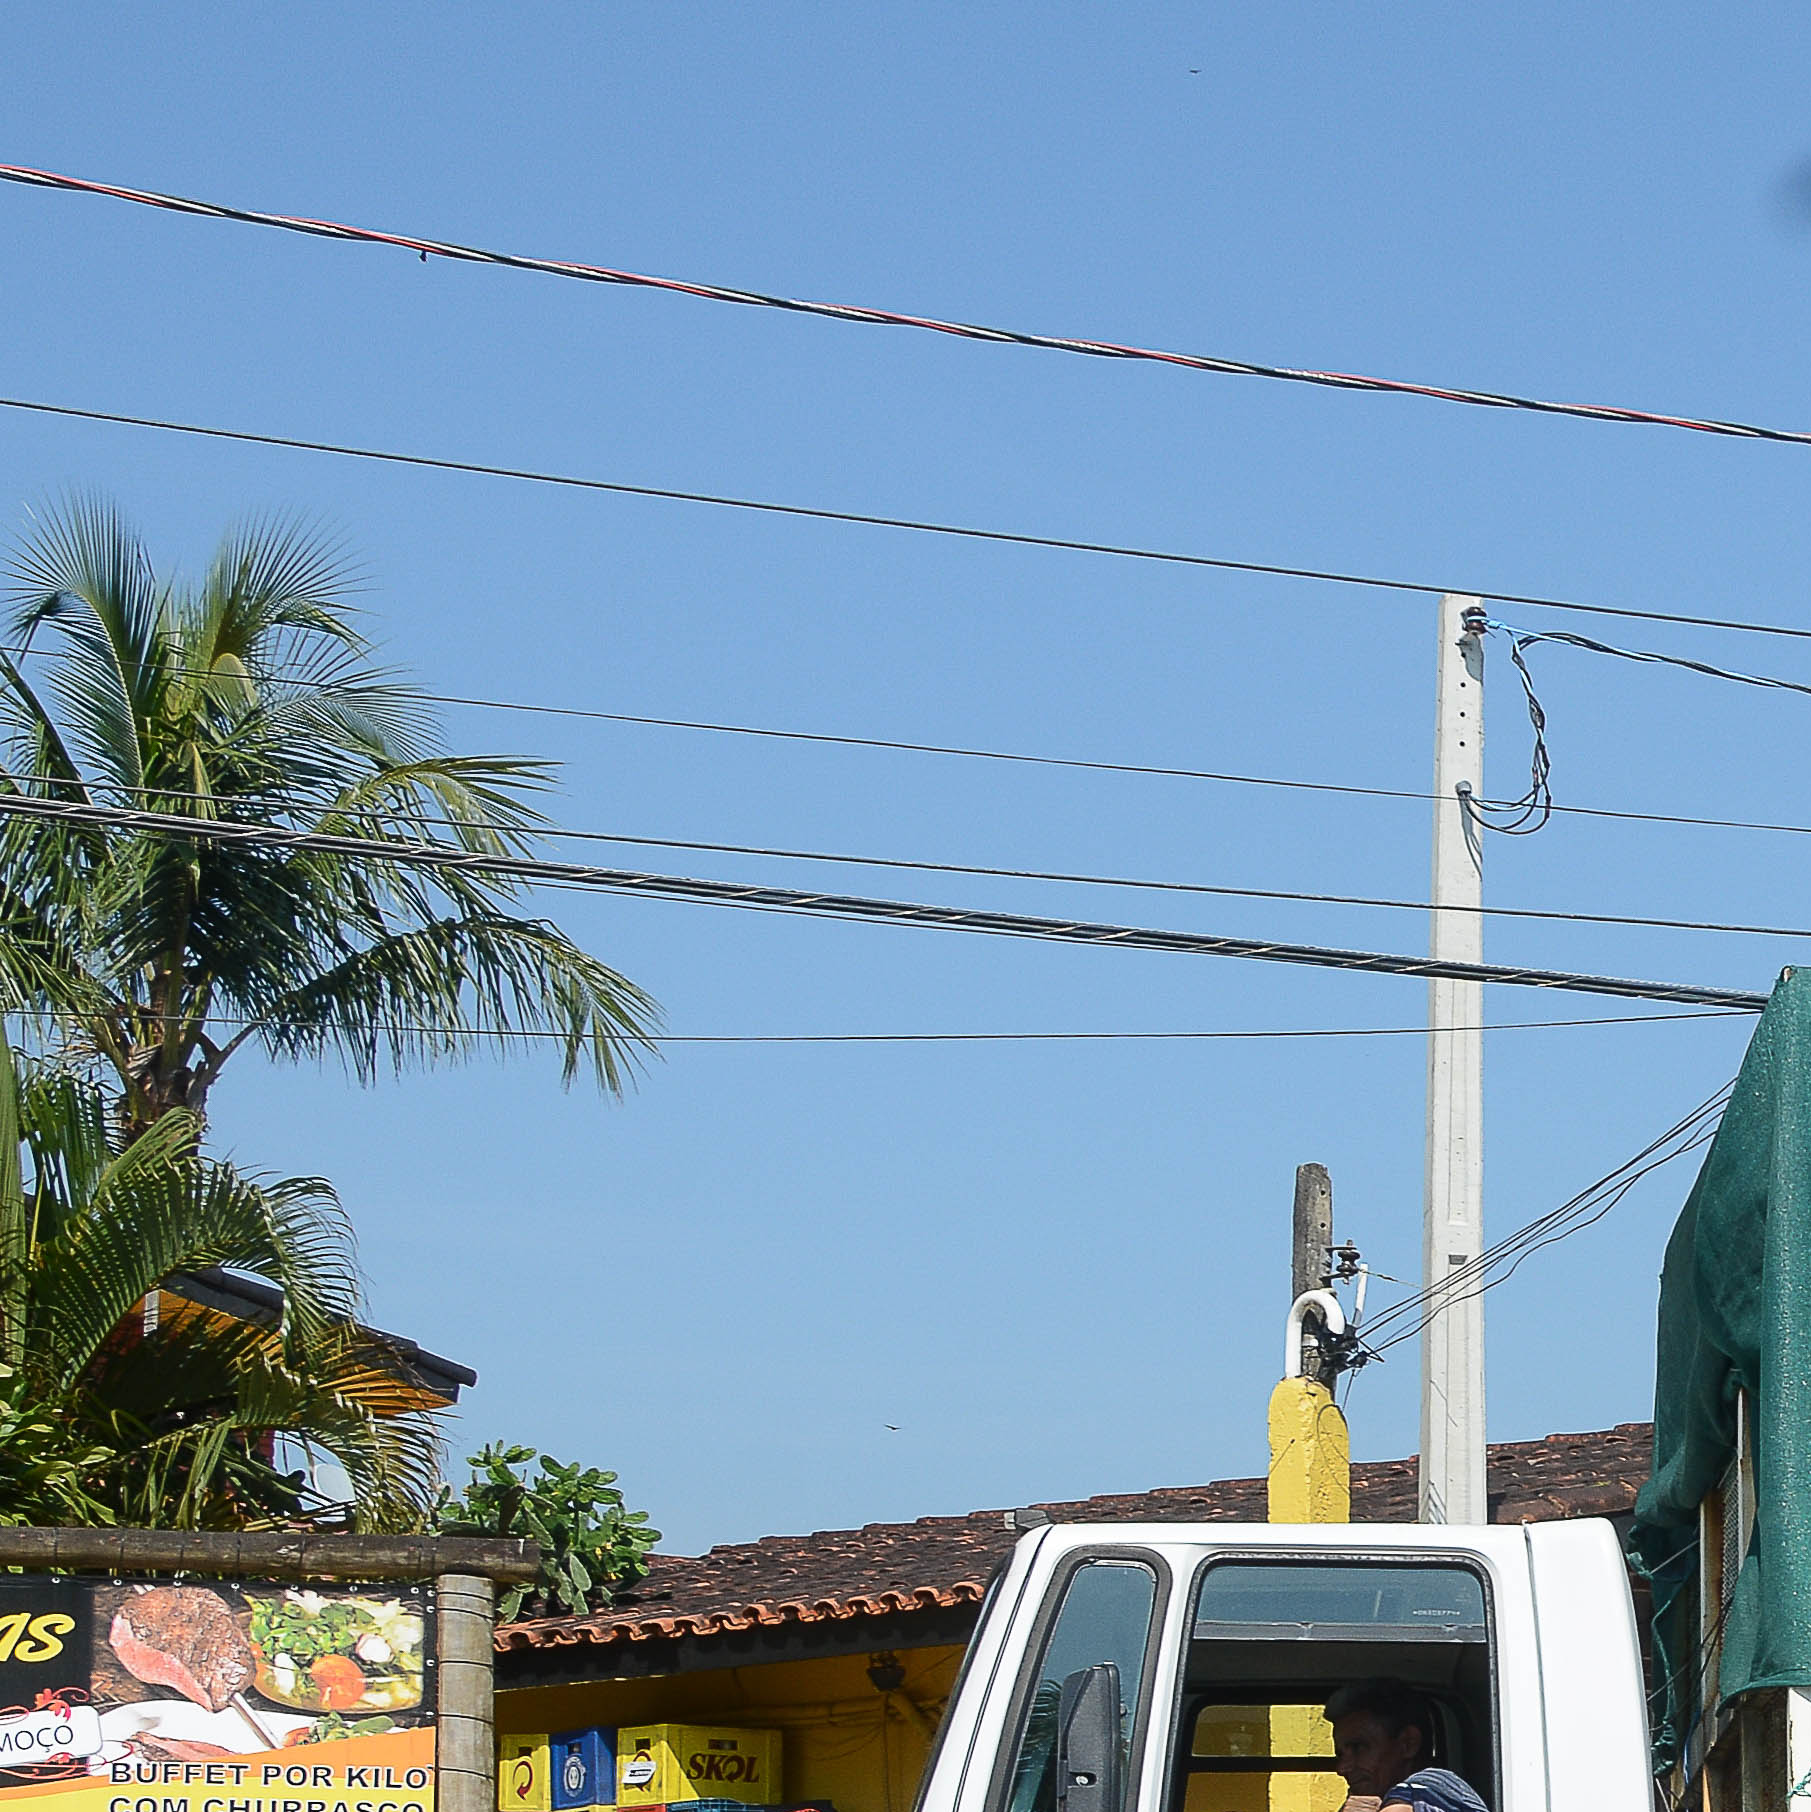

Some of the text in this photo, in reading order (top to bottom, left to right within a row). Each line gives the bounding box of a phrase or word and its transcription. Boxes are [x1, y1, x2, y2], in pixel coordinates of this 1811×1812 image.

[110, 1763, 428, 1789] BUFFET POR KILO
[686, 1752, 760, 1784] SKOL
